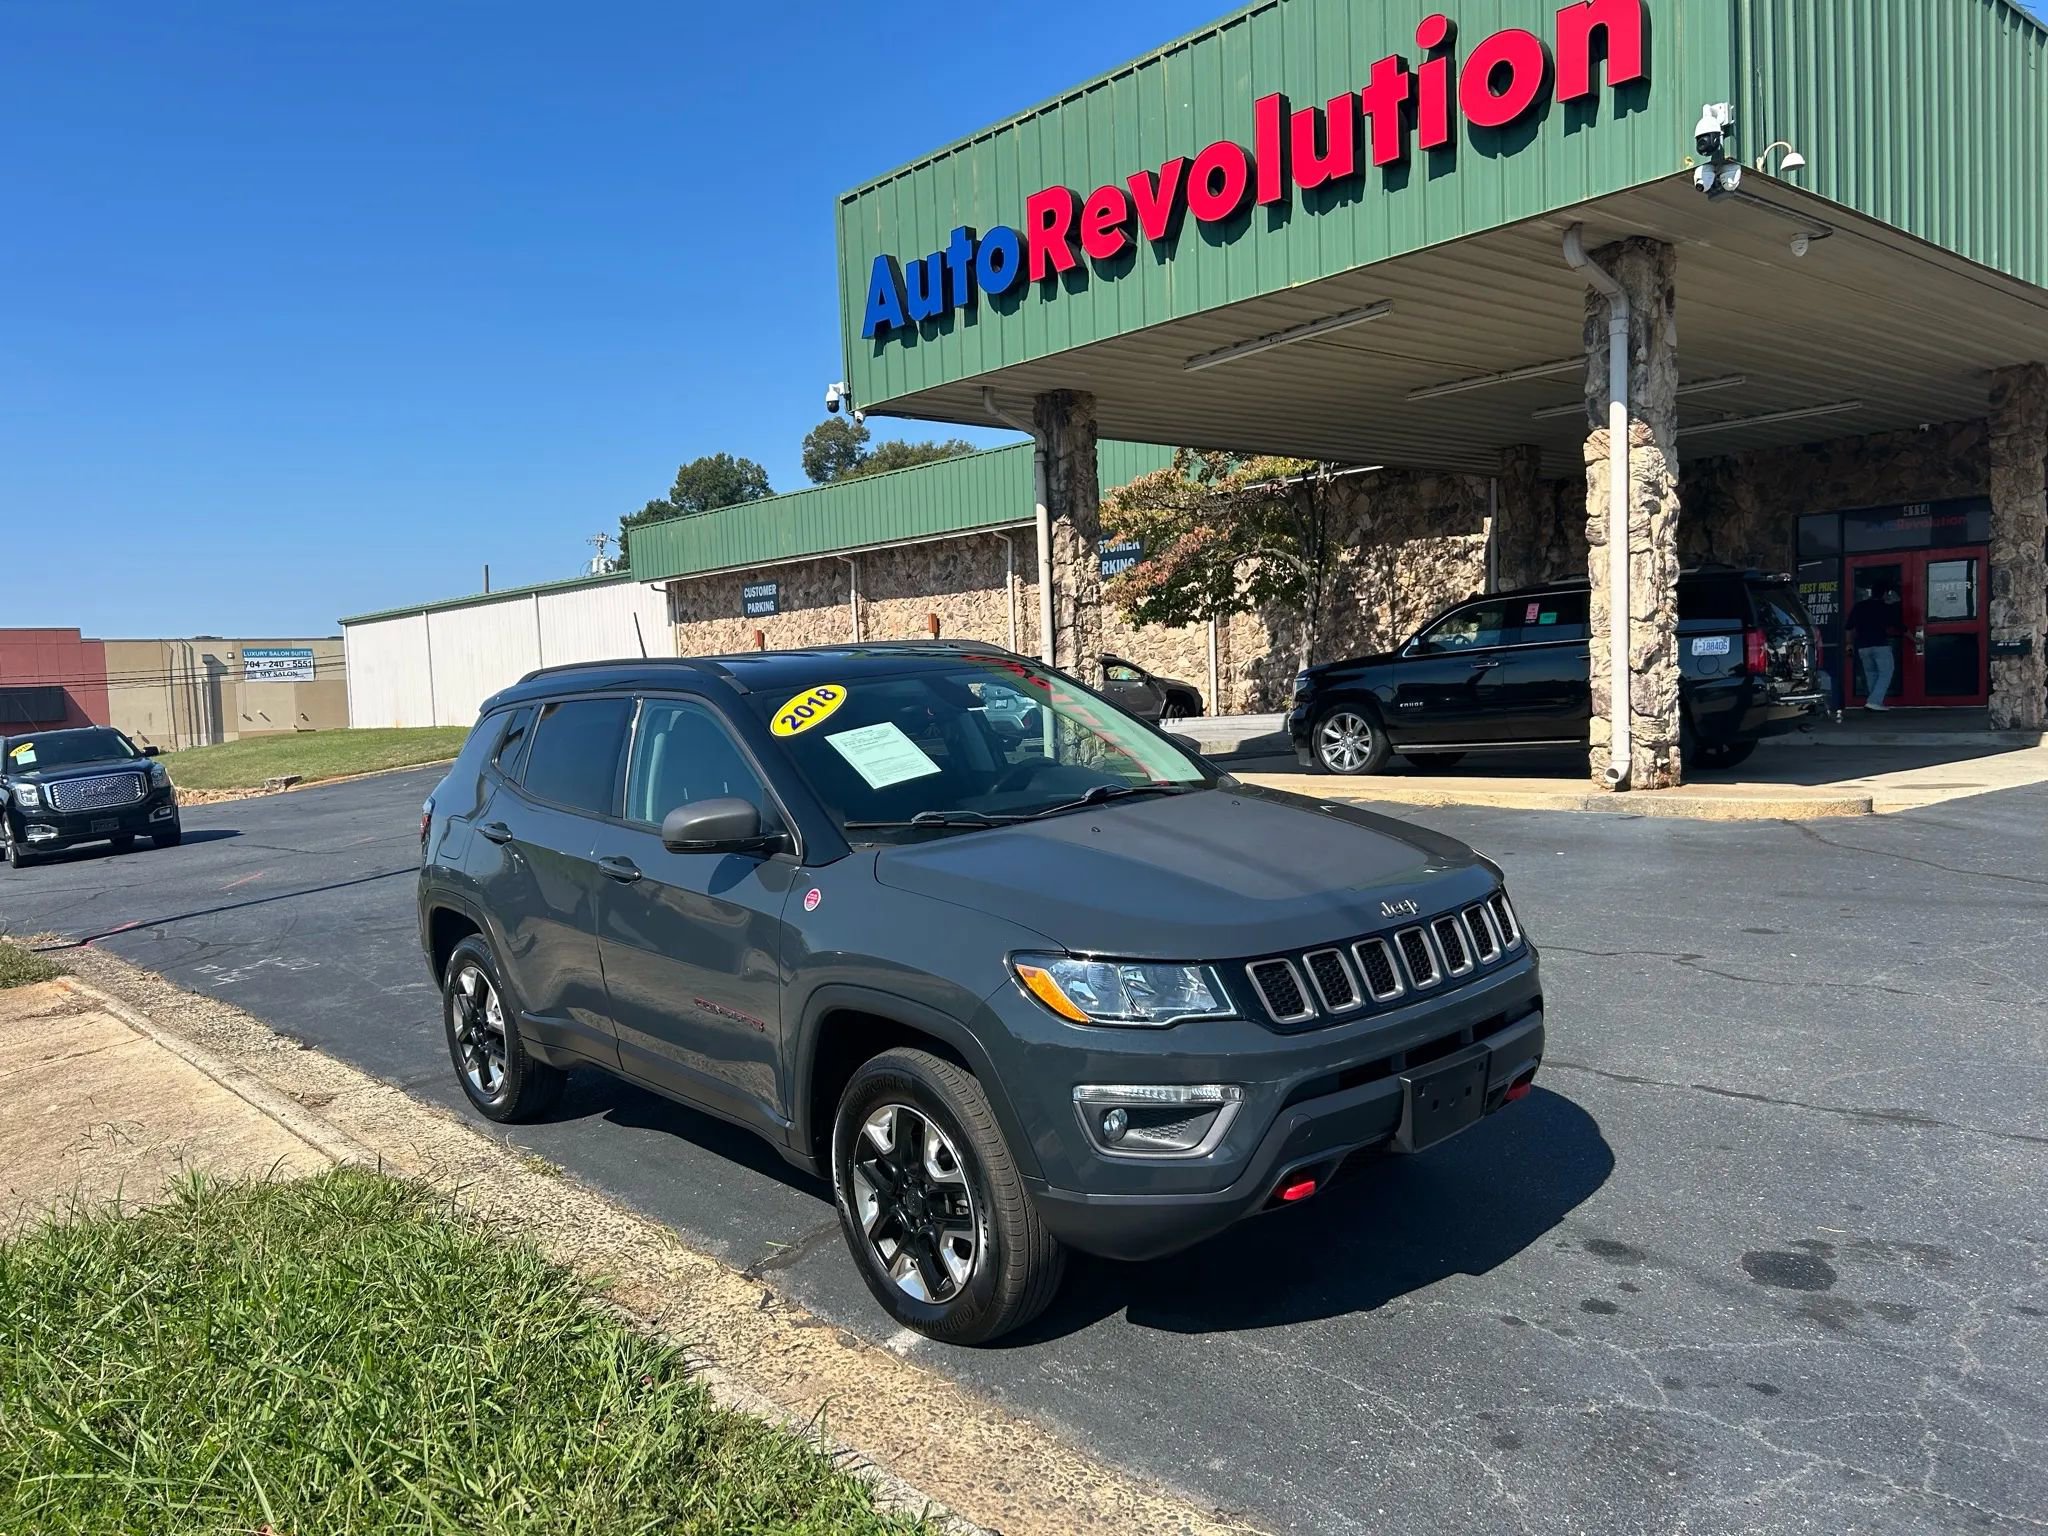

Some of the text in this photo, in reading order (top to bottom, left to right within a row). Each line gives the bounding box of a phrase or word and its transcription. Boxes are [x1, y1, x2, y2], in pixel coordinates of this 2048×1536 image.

[1866, 516, 1968, 533] Revolution
[1098, 538, 1140, 554] STMER
[1102, 558, 1135, 575] RKIN
[743, 584, 777, 598] CUSTOMER
[1800, 581, 1839, 593] BEST PRICE
[1807, 593, 1831, 603] IN THE
[747, 601, 775, 614] PARKING
[292, 660, 312, 668] 5551
[781, 689, 837, 731] 2018
[1381, 900, 1419, 918] Jeep
